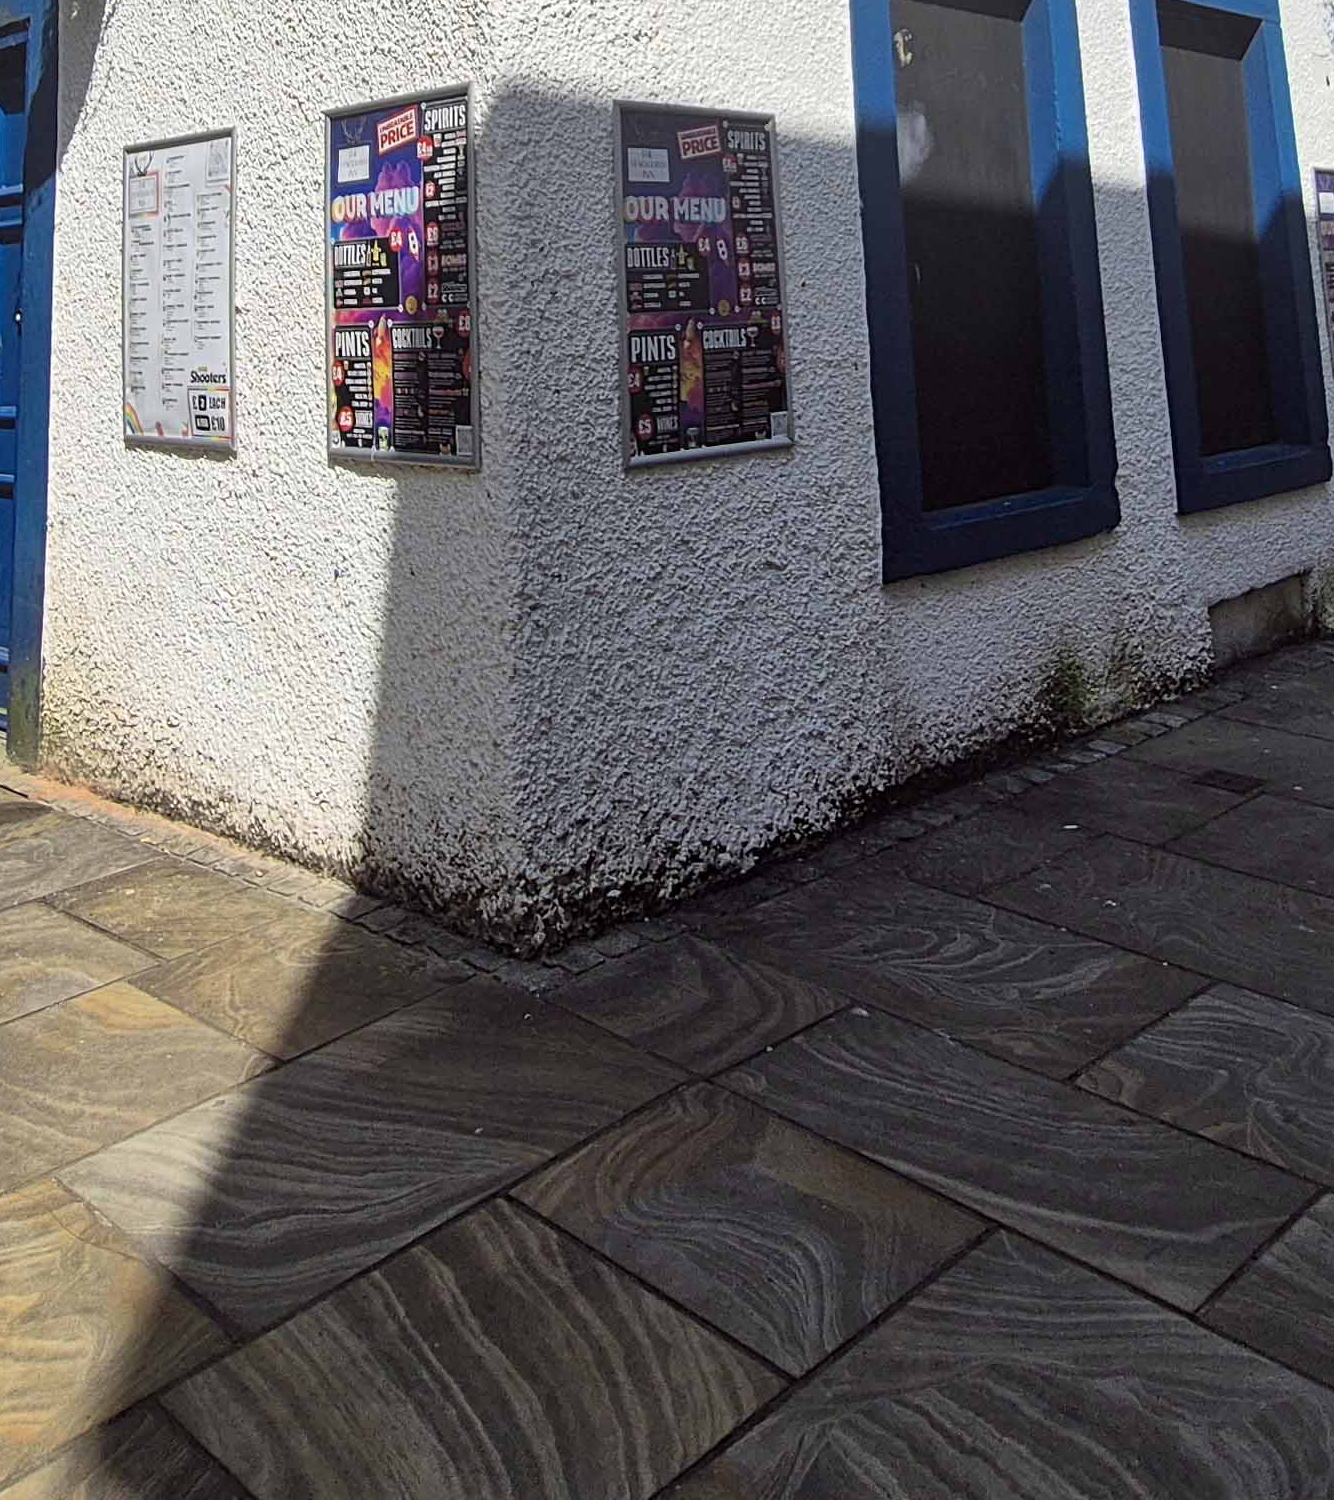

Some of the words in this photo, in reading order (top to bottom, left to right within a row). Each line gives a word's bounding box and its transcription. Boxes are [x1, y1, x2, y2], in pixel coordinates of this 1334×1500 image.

[424, 104, 466, 132] SPIRITS
[380, 121, 414, 149] PRICE
[681, 135, 718, 156] PRICE
[727, 130, 766, 151] SPIRITS
[332, 193, 367, 222] OUR
[370, 186, 419, 216] MENU
[625, 196, 669, 221] OUR
[673, 197, 727, 222] MENU
[334, 244, 366, 267] BOTTLES
[627, 247, 670, 268] BOTTLES
[335, 330, 370, 357] PINTS
[392, 327, 432, 349] COCKTAILS
[631, 334, 676, 363] PINTS
[703, 328, 747, 349] COCKTAILS
[190, 370, 227, 384] Shooters
[211, 416, 225, 432] £10
